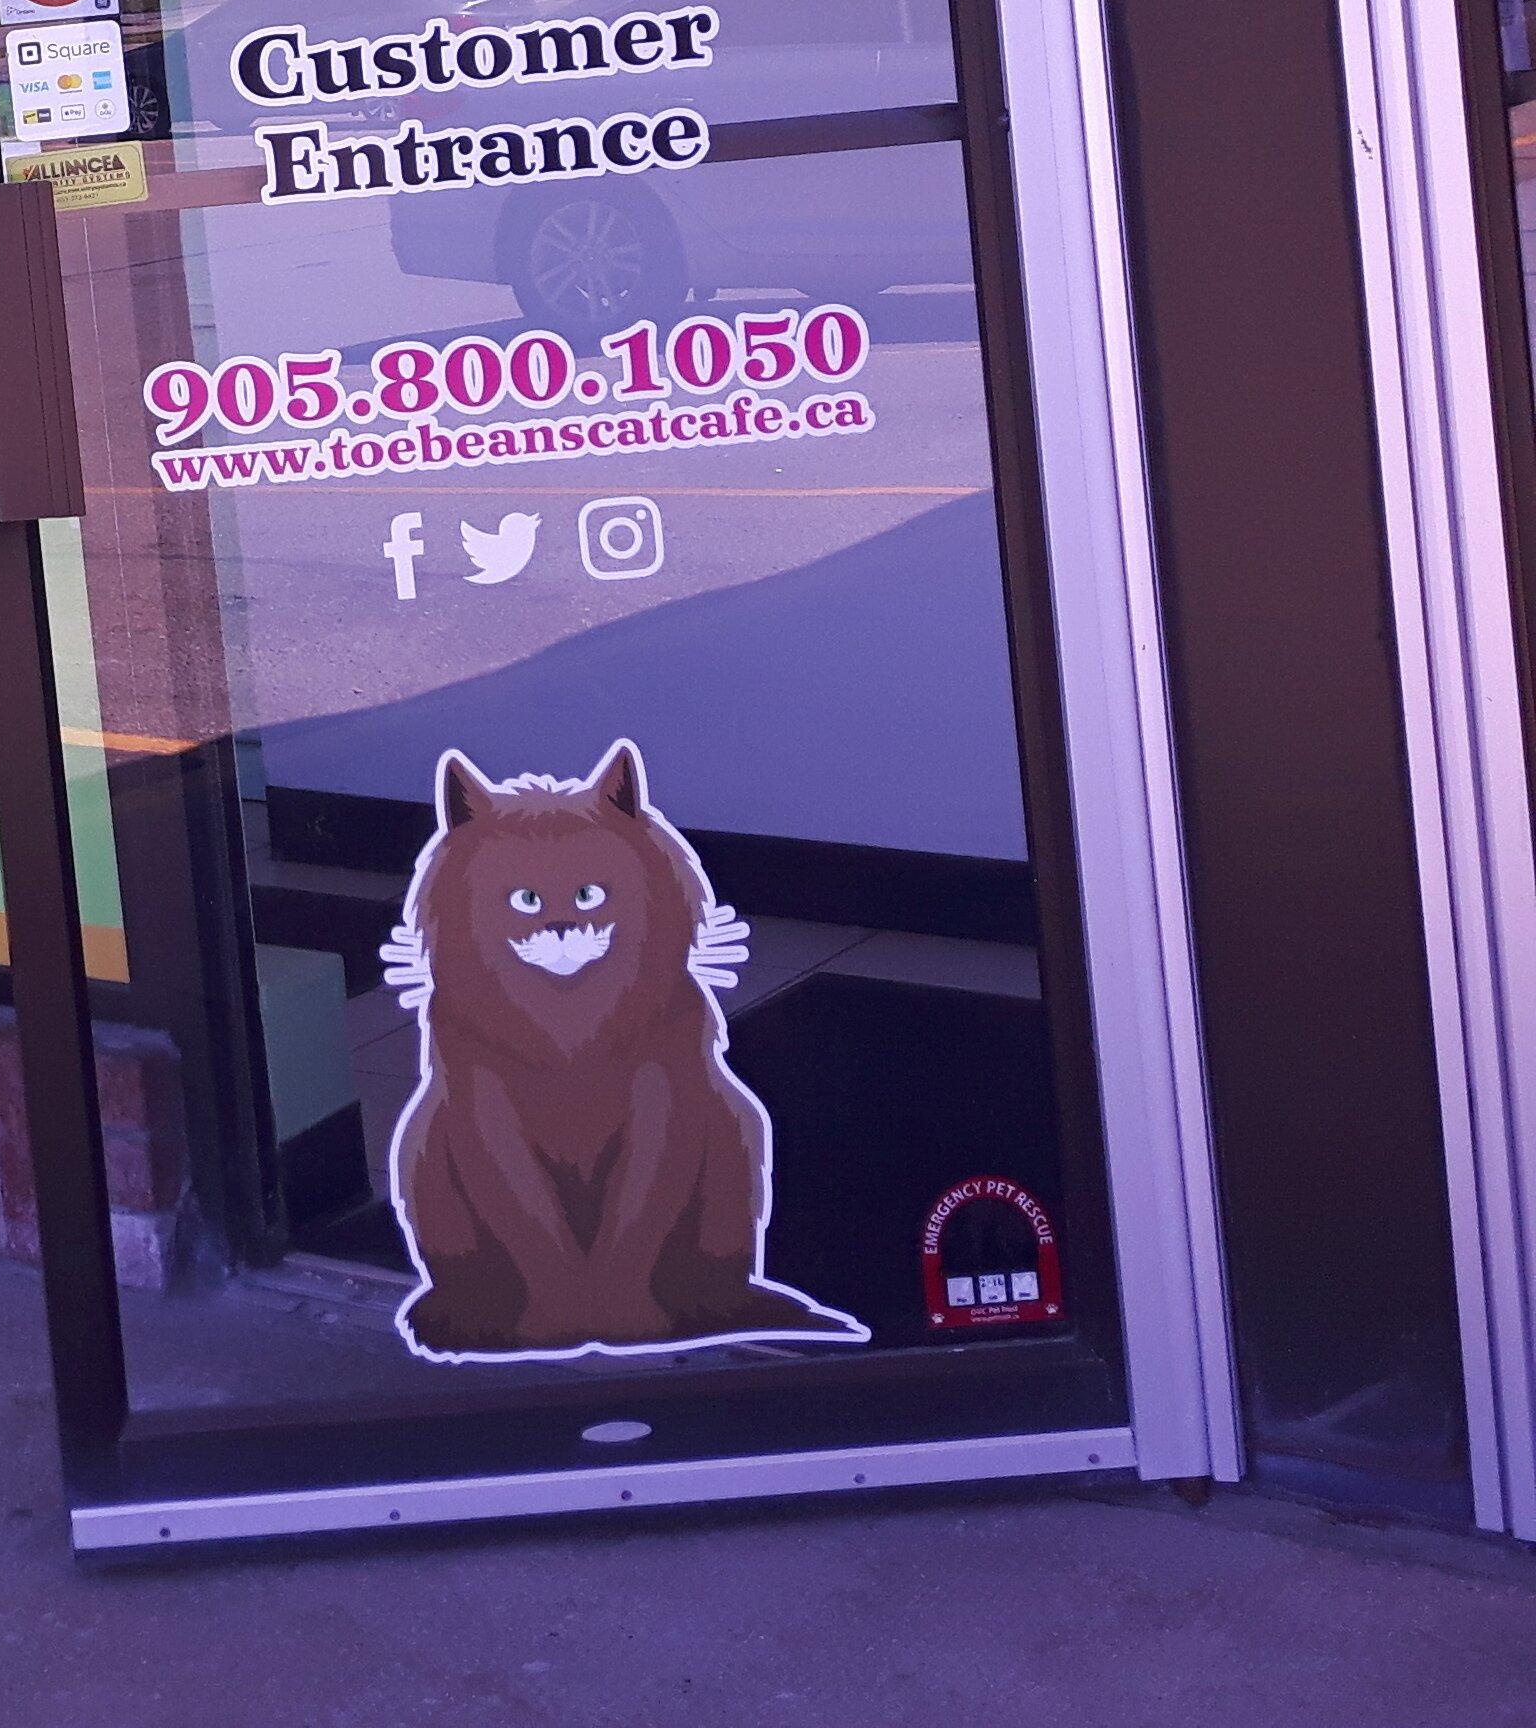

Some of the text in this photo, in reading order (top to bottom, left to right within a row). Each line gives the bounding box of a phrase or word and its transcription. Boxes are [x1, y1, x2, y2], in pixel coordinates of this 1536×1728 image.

[18, 80, 50, 94] VISA
[46, 40, 111, 61] Square
[235, 6, 717, 103] Customer
[264, 110, 705, 200] Entrance
[149, 310, 868, 441] 905.800.1050
[158, 395, 868, 488] www.toebeanscatcafe.ca
[924, 1179, 1054, 1255] EMERGENCY PET RESCUE
